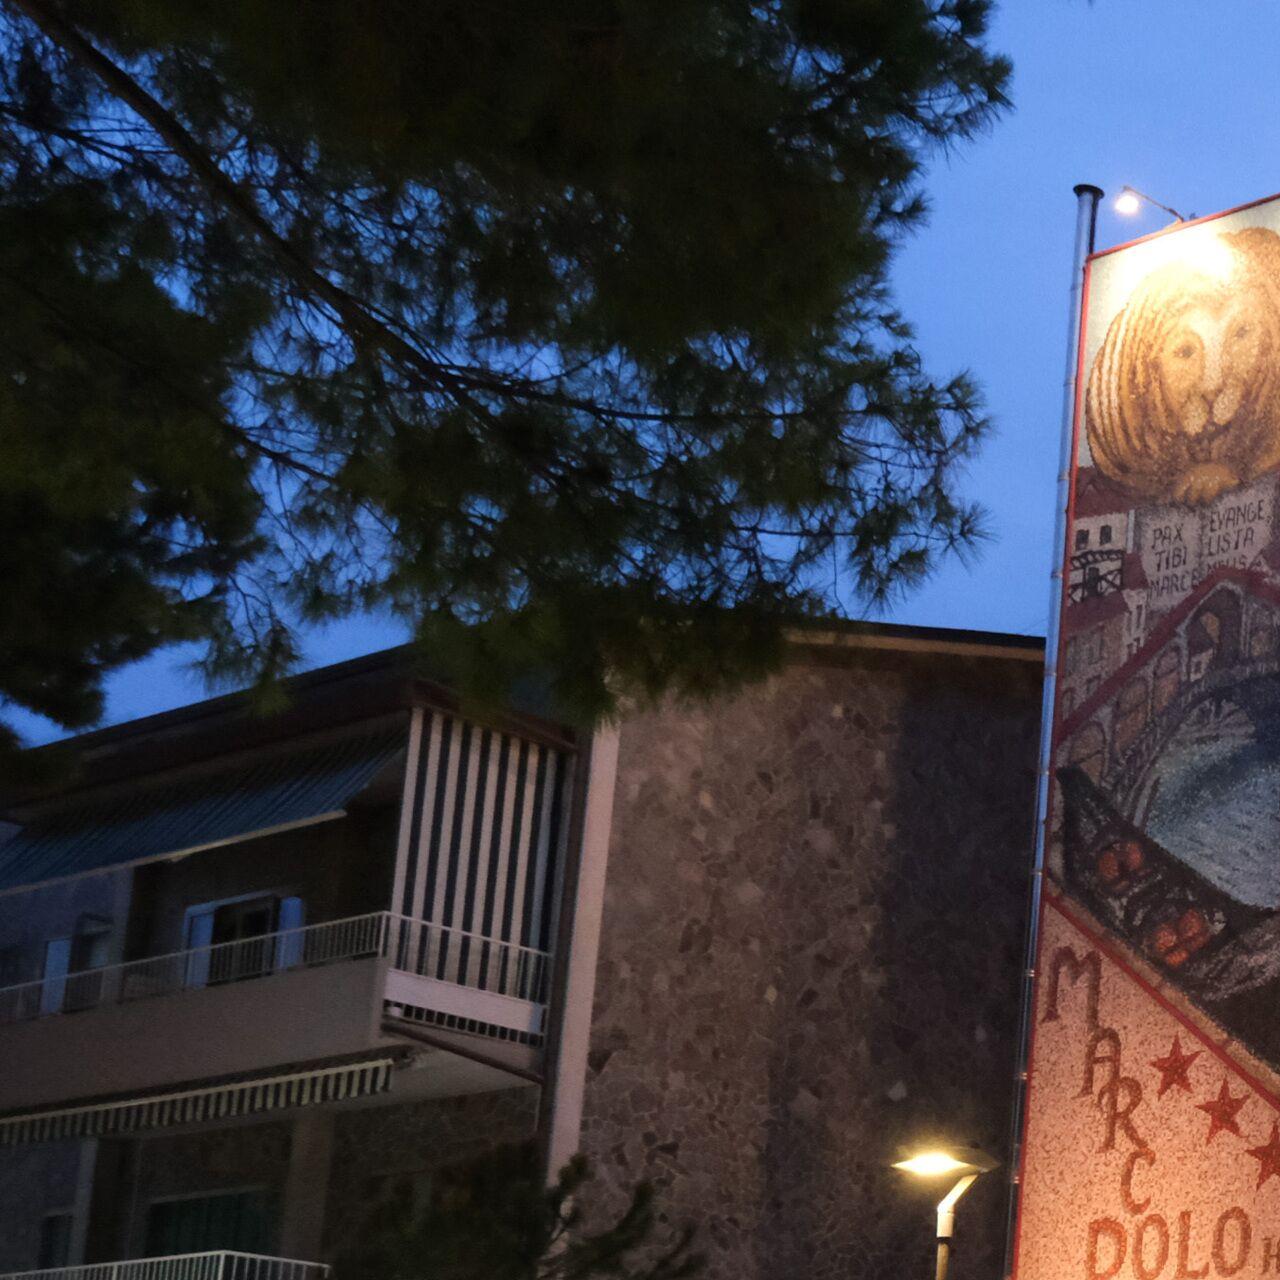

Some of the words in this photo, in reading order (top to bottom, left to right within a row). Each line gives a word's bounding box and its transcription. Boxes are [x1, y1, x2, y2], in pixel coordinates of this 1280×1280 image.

[1151, 523, 1184, 549] PAX
[1207, 527, 1255, 557] LISTA
[1155, 546, 1187, 572] TIBI
